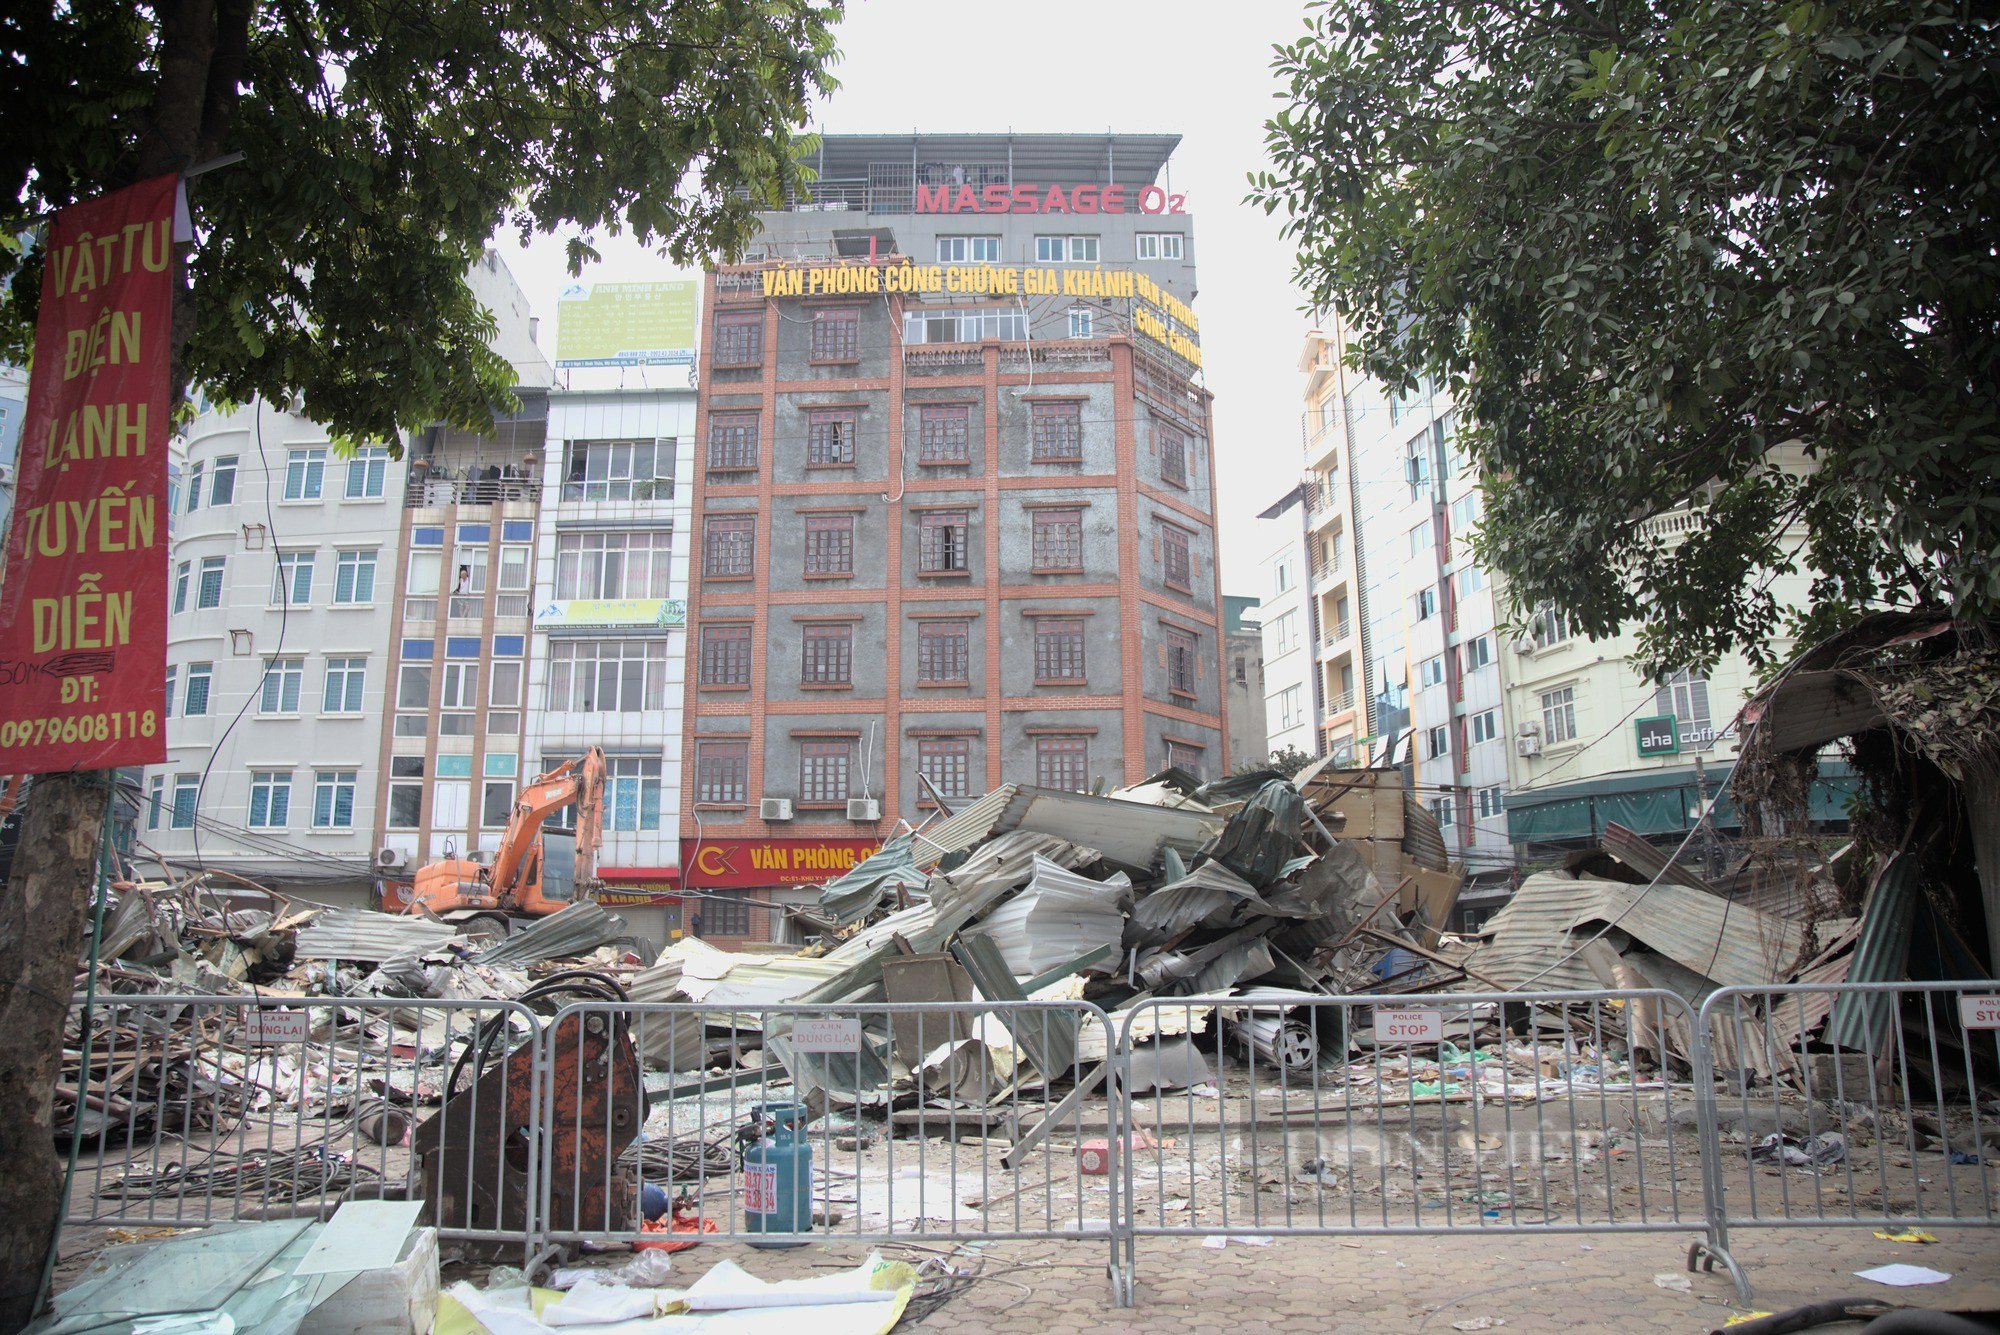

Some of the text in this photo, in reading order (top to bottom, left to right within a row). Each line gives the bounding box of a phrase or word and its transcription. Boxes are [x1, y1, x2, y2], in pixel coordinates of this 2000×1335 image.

[916, 184, 1125, 214] MASSAGE
[53, 231, 118, 302] VẬT
[762, 260, 1134, 297] VĂN PHÒNG CÔNG CHỨNG GIA KHÁNH
[656, 283, 684, 291] LAND
[64, 306, 141, 381] ĐIỆN
[45, 403, 147, 472] LẠNH
[24, 480, 154, 560] TUYẾN
[32, 572, 132, 654] DIỄN
[60, 676, 98, 704] ĐT:
[1, 710, 156, 748] 0979608118
[1642, 727, 1735, 748] aha coffee
[750, 844, 788, 869] VĂN
[793, 843, 855, 870] PHÒNG
[1388, 1024, 1428, 1036] STOP
[1976, 1010, 2000, 1022] ST
[284, 1026, 302, 1037] LẠI
